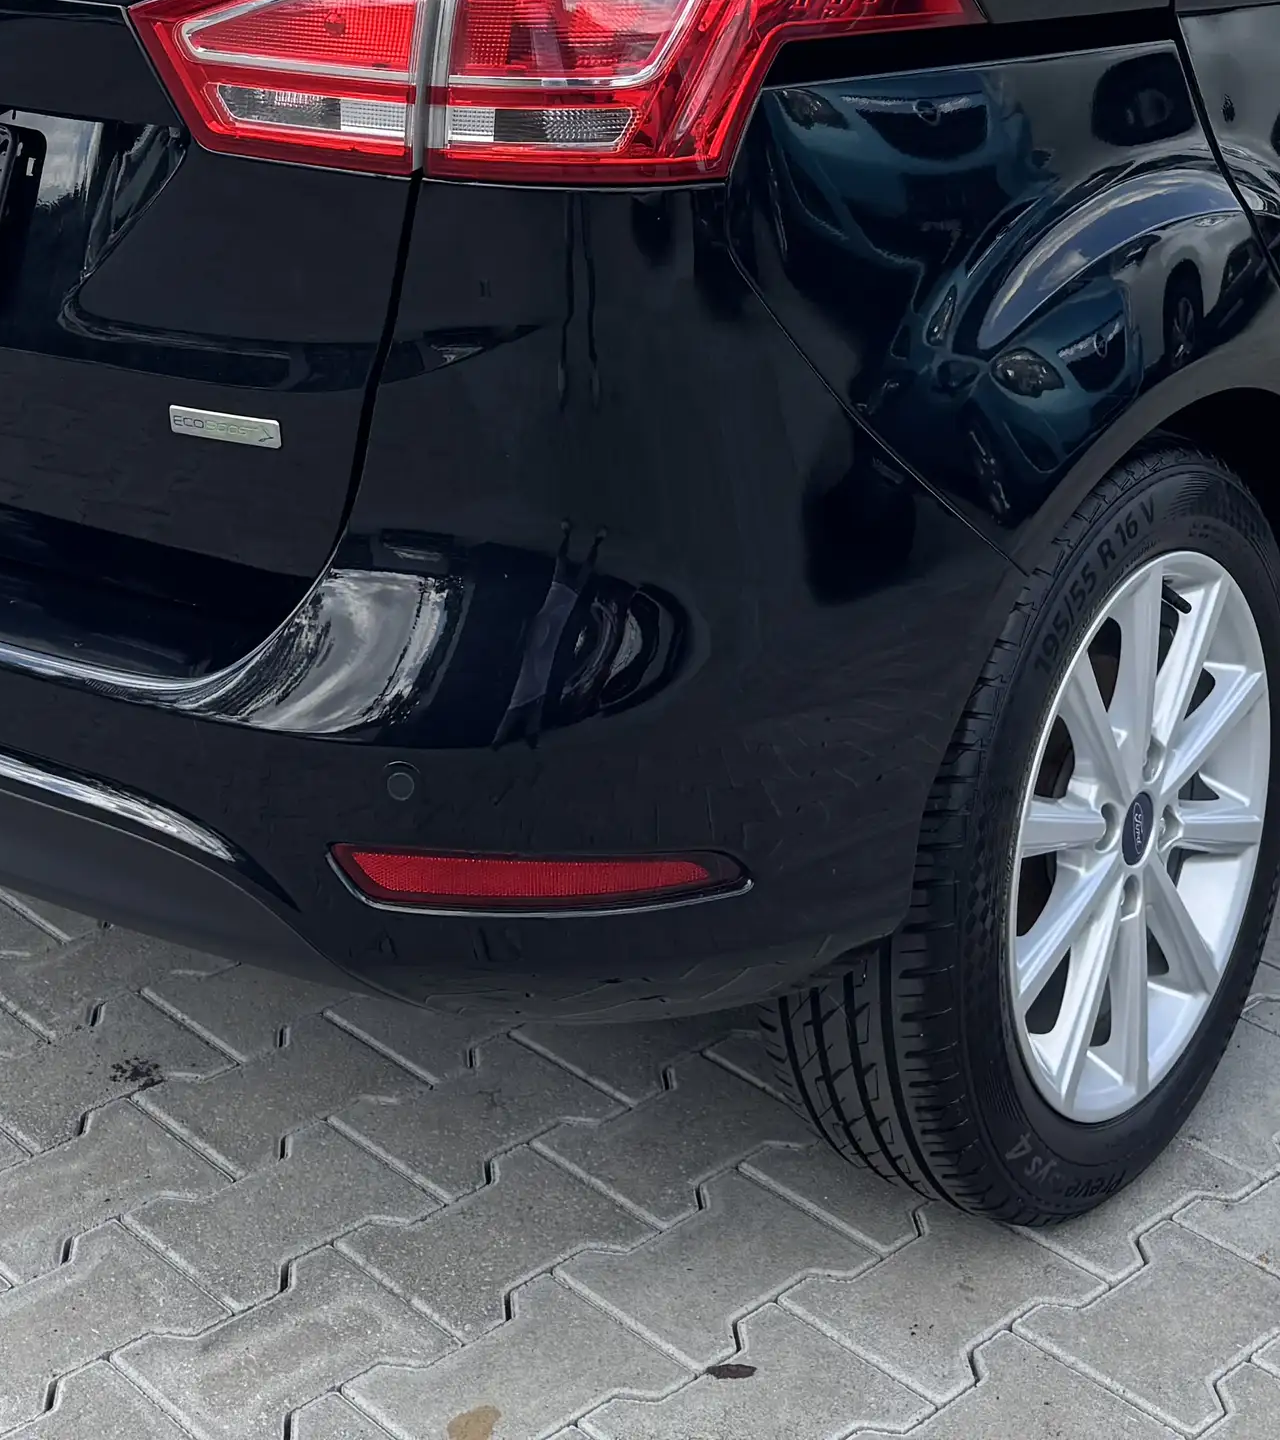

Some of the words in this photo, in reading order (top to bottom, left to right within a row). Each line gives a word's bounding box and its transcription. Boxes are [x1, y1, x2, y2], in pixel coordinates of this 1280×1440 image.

[1034, 562, 1099, 672] 195/55
[1096, 538, 1117, 570] R
[1114, 512, 1139, 547] 16
[1141, 496, 1156, 526] V
